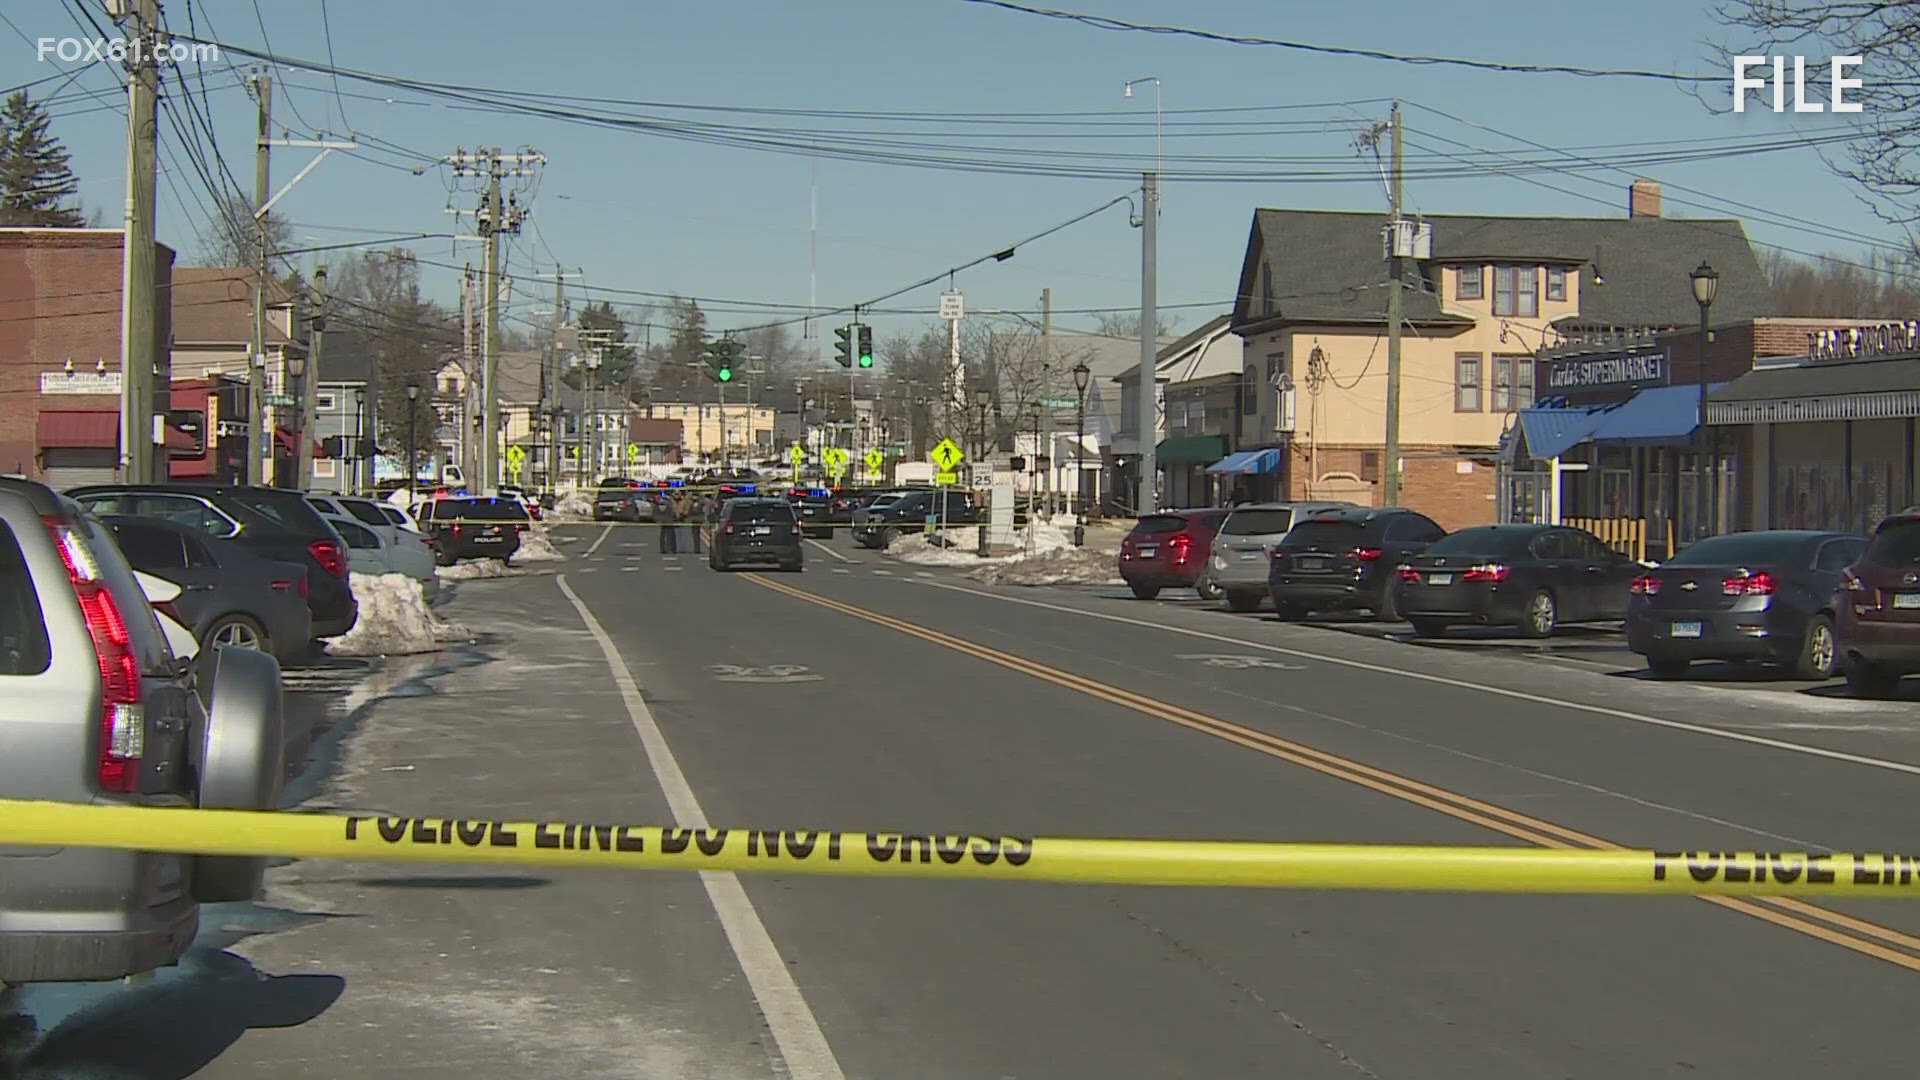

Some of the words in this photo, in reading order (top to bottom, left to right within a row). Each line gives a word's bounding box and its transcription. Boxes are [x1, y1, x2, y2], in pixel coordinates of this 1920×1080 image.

[1807, 327, 1858, 360] HAIR
[1858, 319, 1920, 354] WORL
[1580, 353, 1664, 385] SUPERMARKET
[974, 475, 992, 486] 25
